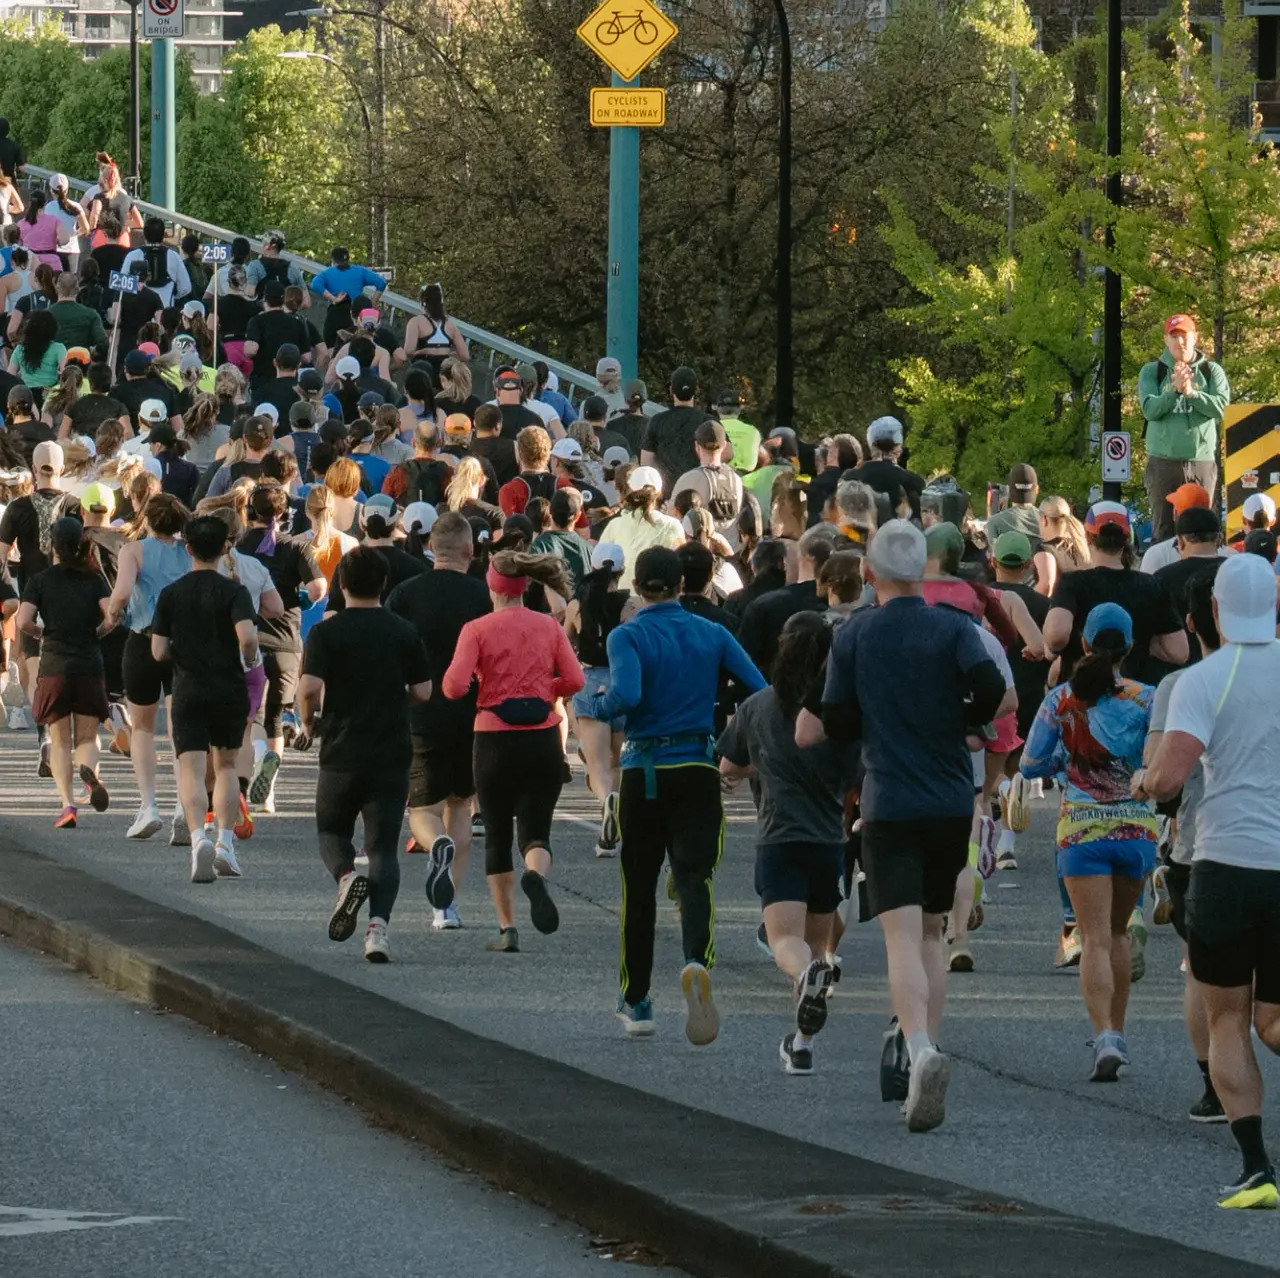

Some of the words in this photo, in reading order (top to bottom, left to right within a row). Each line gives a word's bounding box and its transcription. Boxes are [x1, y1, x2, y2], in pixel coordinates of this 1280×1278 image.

[148, 26, 179, 34] BRIDGE
[607, 96, 648, 106] CYCLISTS
[597, 108, 610, 118] ON
[614, 108, 659, 118] ROADWAY
[203, 245, 227, 260] 2:05
[111, 273, 135, 290] 2:05
